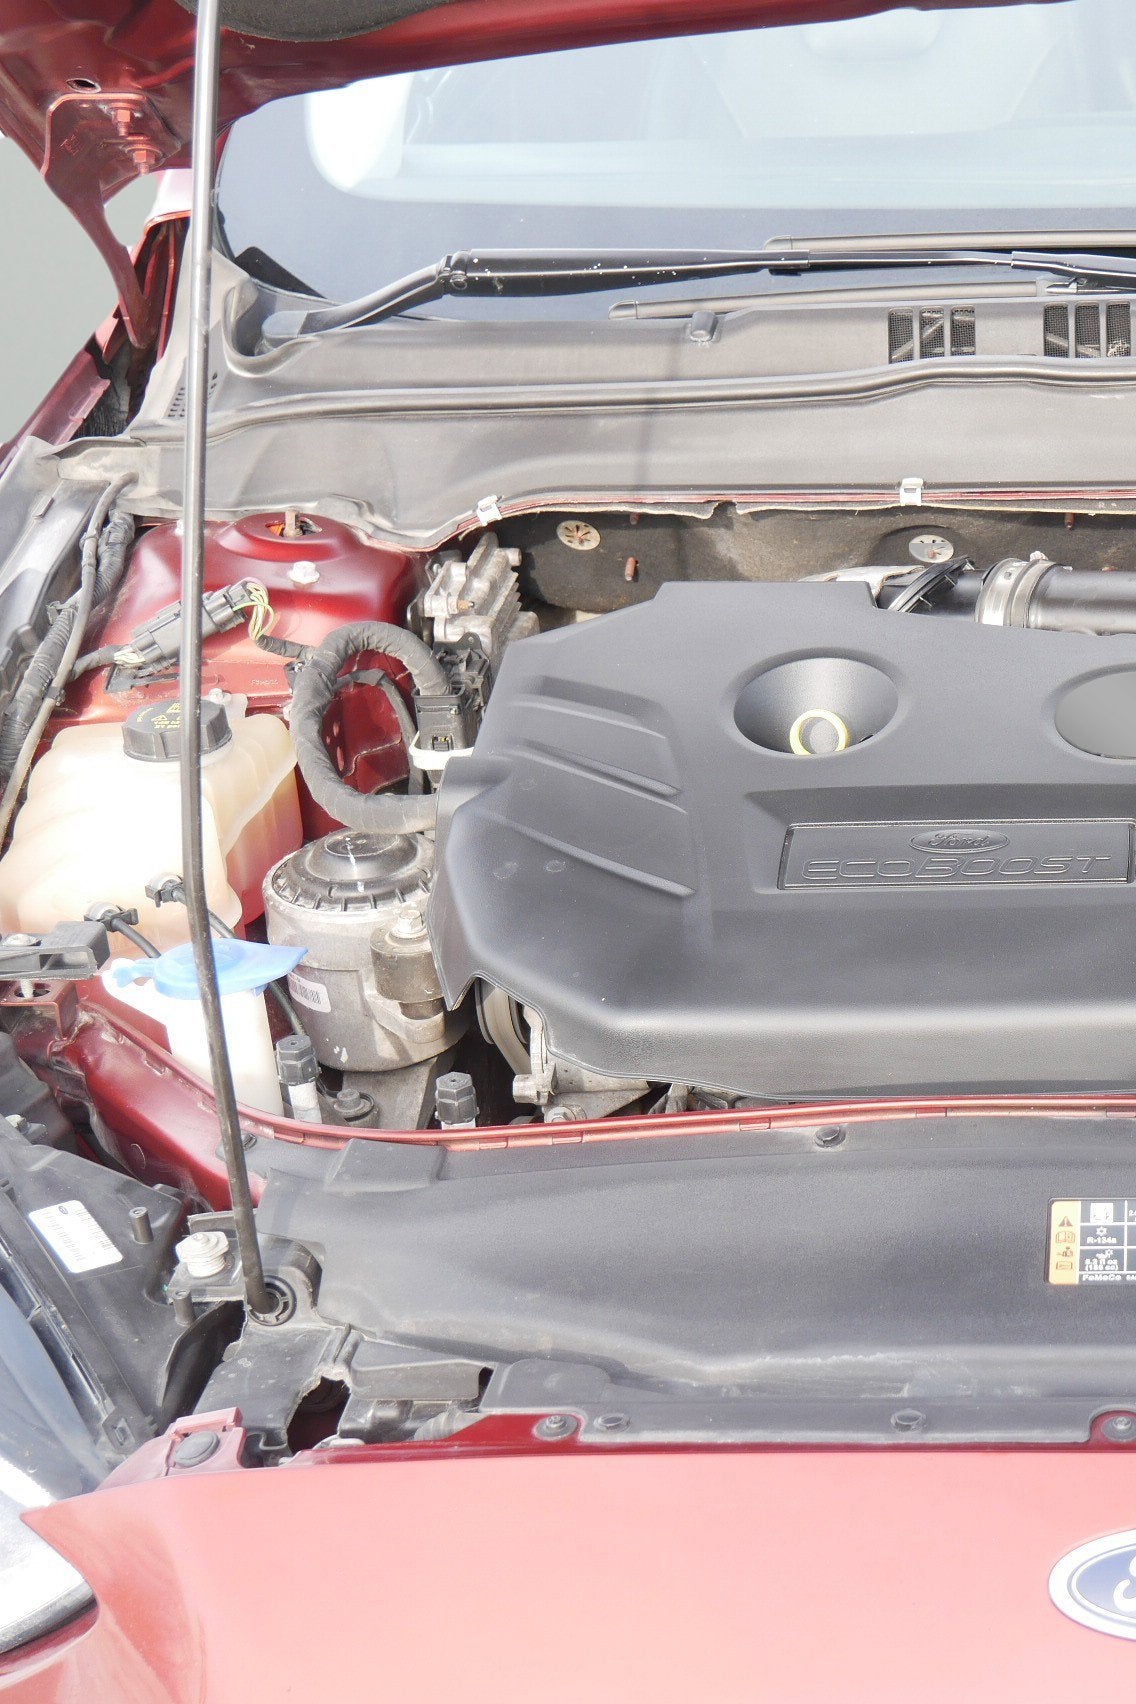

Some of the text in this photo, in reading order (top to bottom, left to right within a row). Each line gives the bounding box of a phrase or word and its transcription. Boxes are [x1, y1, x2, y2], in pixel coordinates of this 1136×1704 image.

[928, 832, 990, 847] Ford
[802, 856, 1112, 880] ECOBOOST
[1087, 1236, 1117, 1244] R-134a
